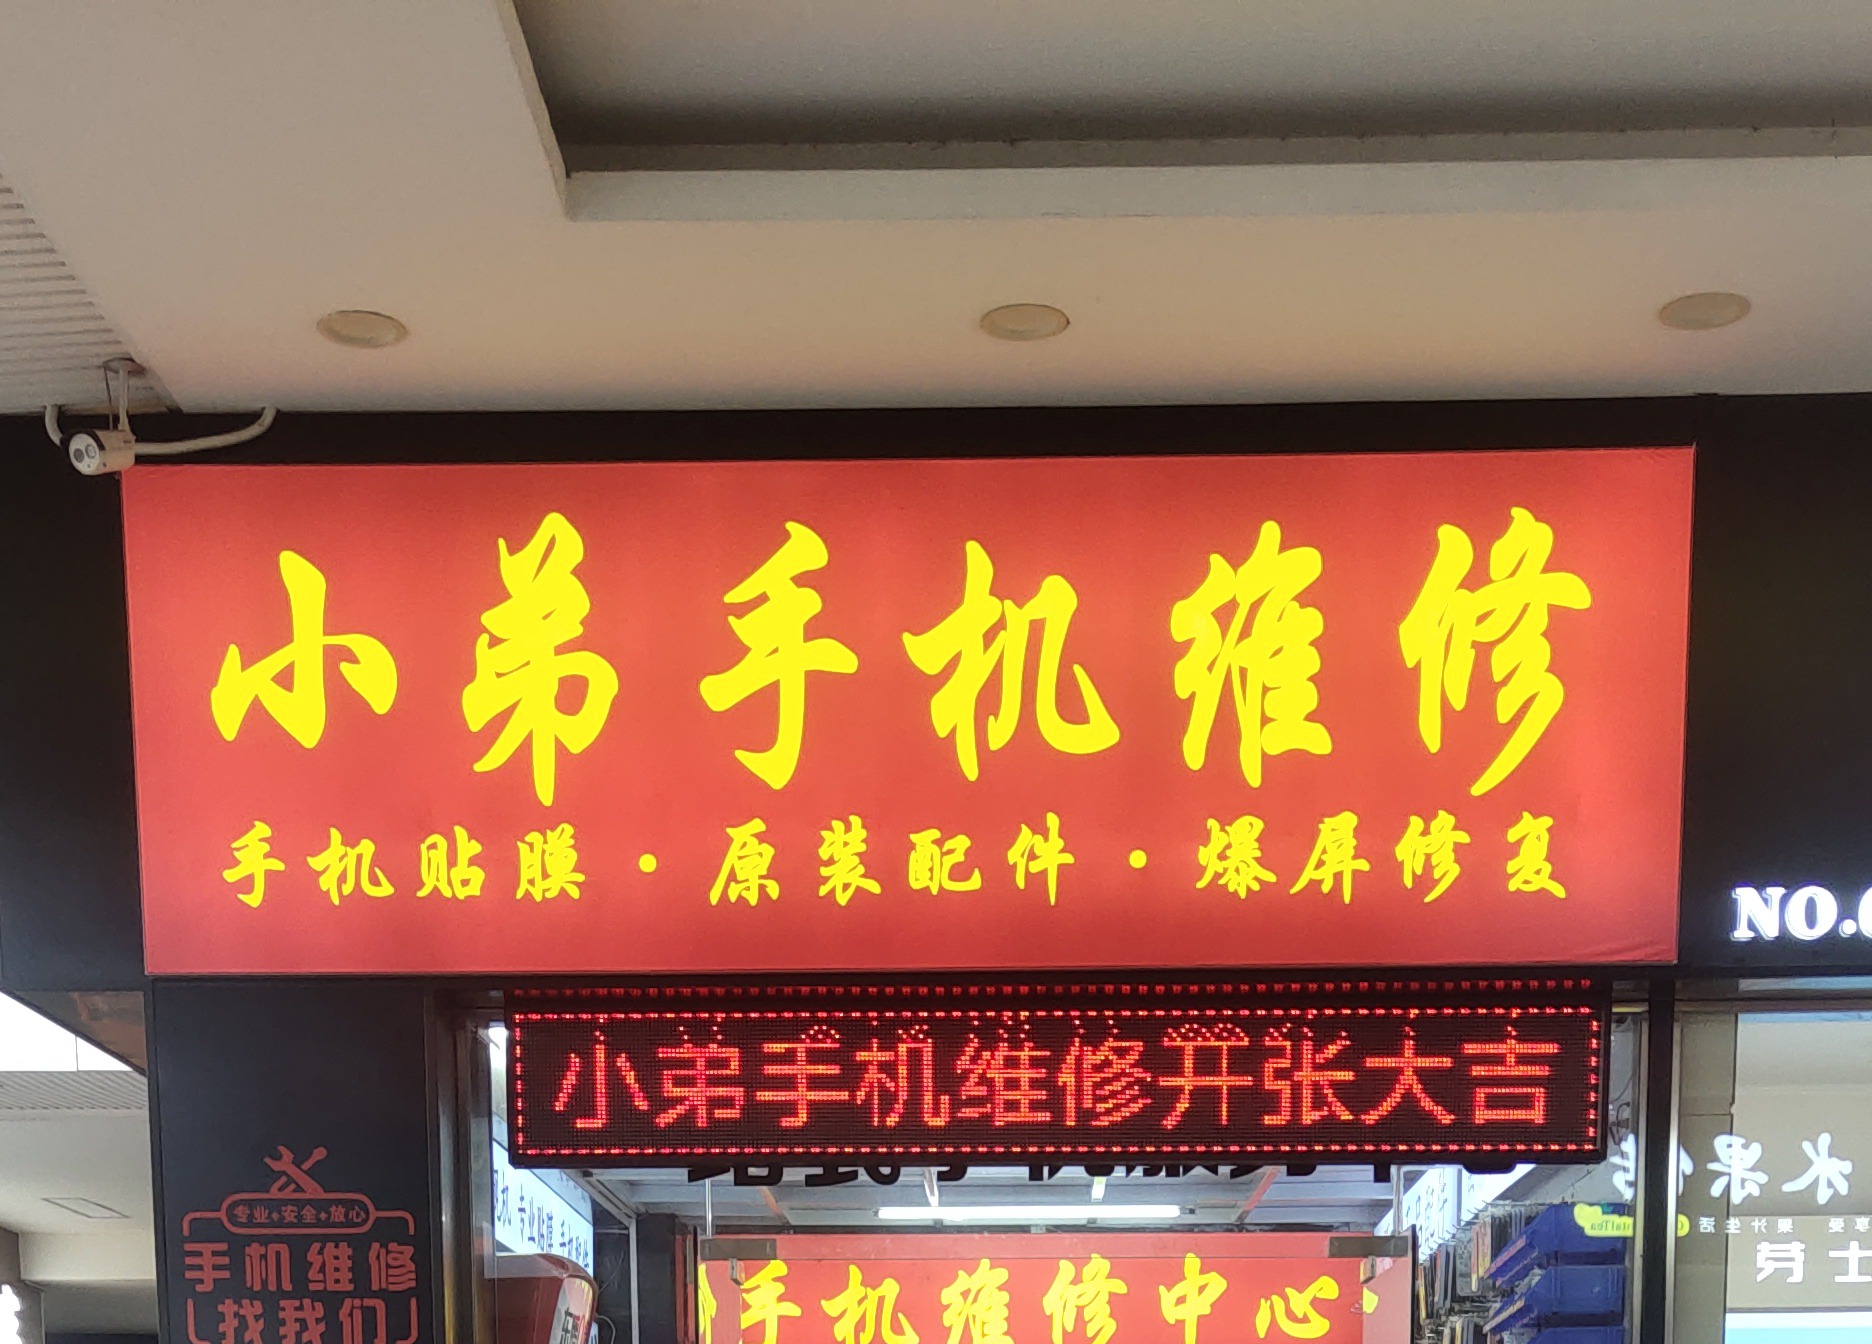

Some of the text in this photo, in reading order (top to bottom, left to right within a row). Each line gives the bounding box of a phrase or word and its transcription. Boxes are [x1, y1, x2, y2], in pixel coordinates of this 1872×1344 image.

[211, 507, 1592, 806] 小弟手机维修
[554, 1028, 1561, 1130] 小弟手机维修开张大吉
[183, 1242, 416, 1292] 手机维修
